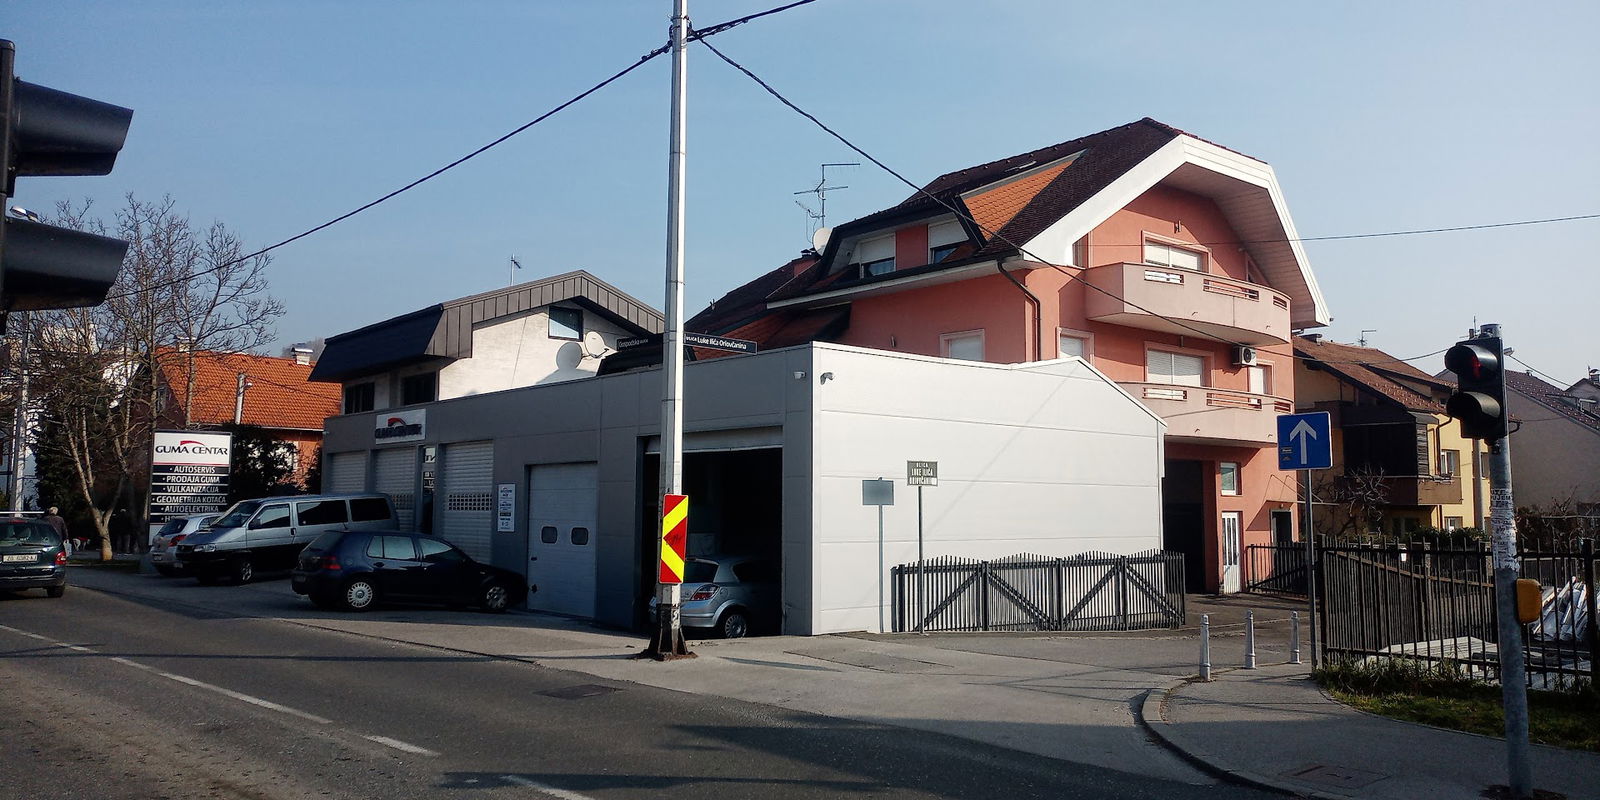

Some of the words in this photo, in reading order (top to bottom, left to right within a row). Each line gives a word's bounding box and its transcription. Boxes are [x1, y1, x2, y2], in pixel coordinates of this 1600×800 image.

[698, 336, 709, 345] Luke
[710, 338, 719, 346] Ilića
[155, 446, 189, 454] GUMA
[192, 446, 228, 455] CENTAR
